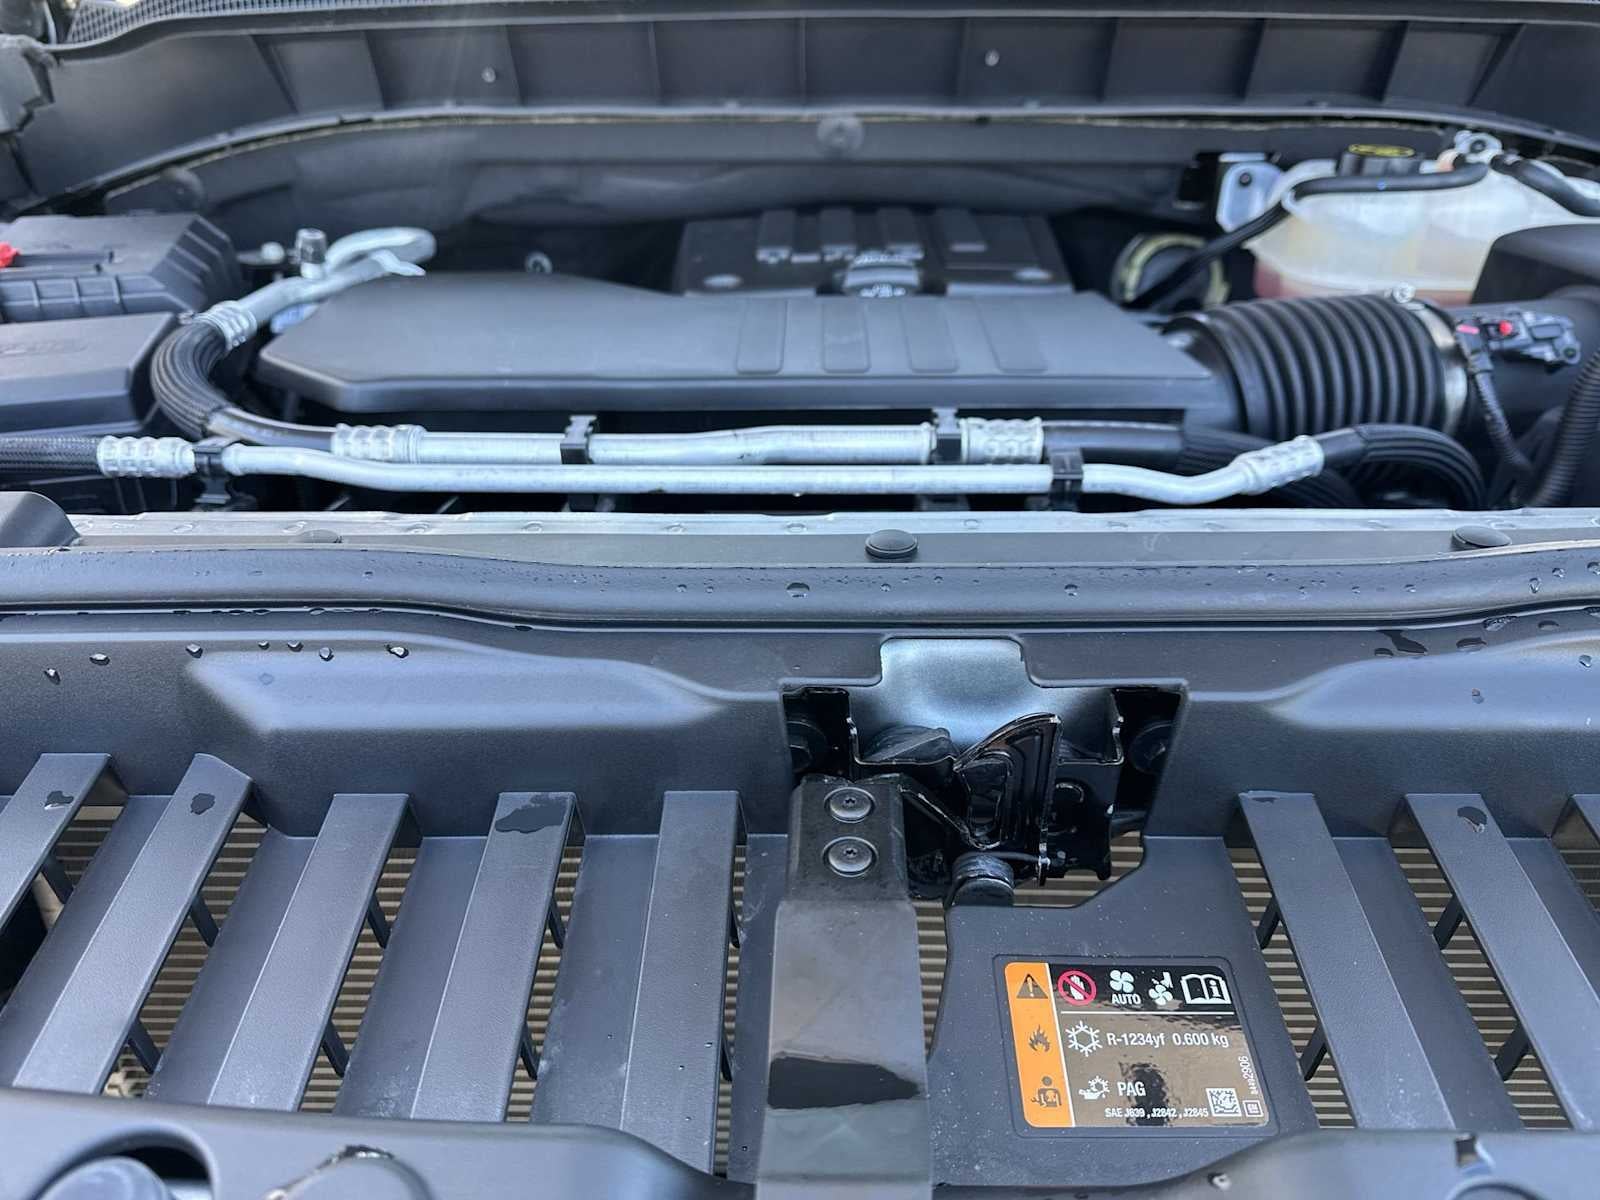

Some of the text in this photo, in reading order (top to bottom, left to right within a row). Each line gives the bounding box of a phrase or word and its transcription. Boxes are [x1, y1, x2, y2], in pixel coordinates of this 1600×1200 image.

[1111, 993, 1142, 1005] AUTO
[1106, 1032, 1229, 1048] R-1234yf 0.600 kg
[1117, 1081, 1147, 1097] PAG
[1104, 1107, 1123, 1118] SAE
